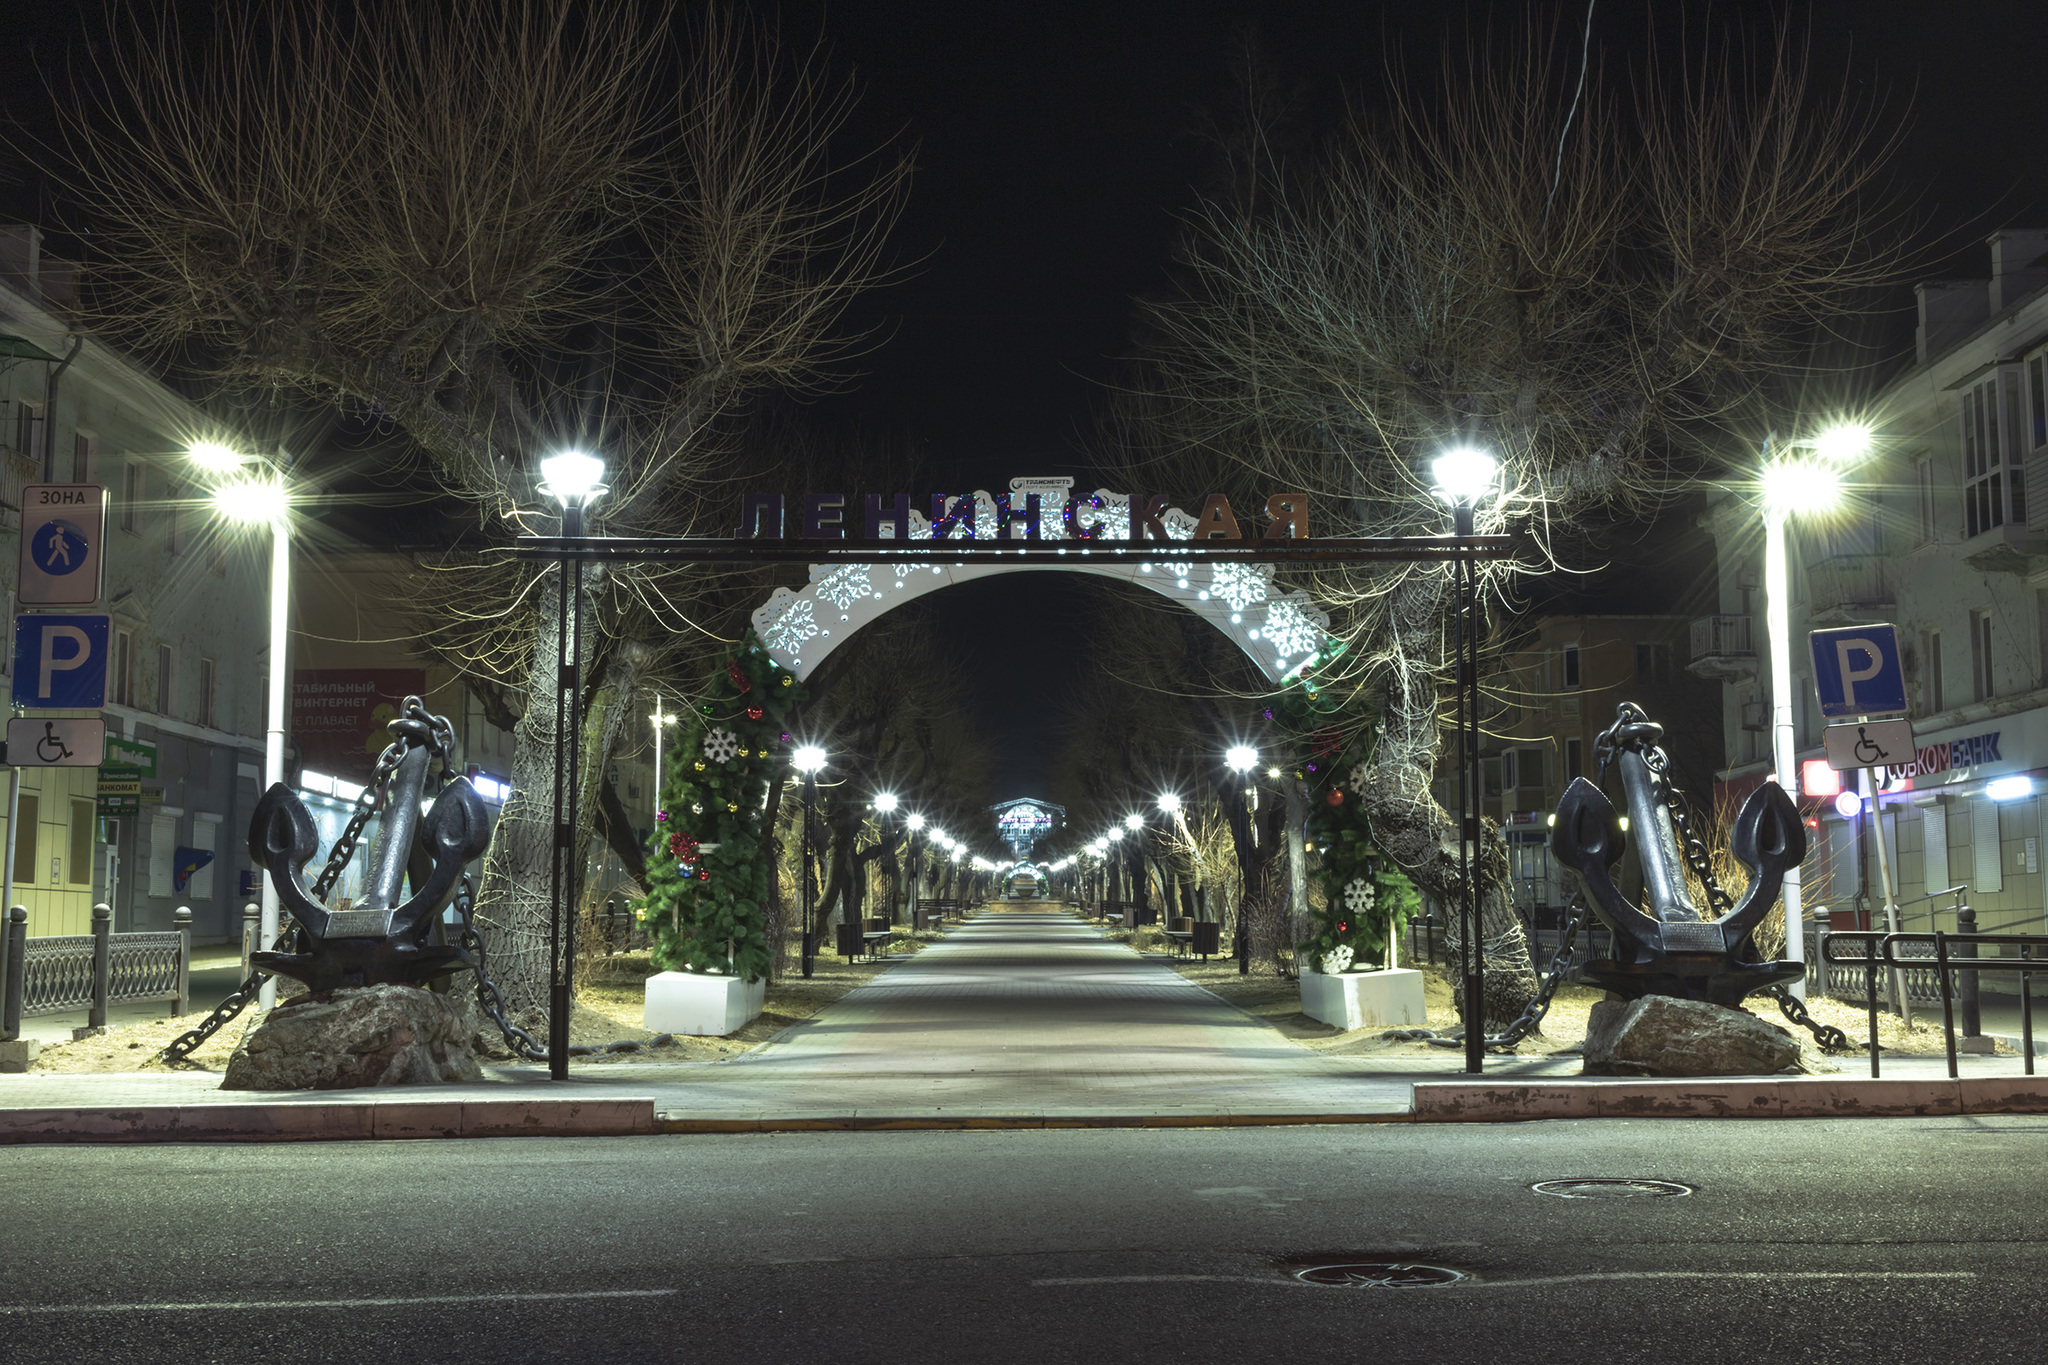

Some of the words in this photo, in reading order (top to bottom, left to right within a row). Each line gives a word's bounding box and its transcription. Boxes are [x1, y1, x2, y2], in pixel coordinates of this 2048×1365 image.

[40, 490, 86, 505] ЗОНА
[733, 492, 1309, 541] ЛЕНИНСКАЯ
[38, 625, 91, 699] P
[1836, 638, 1884, 707] P
[293, 697, 368, 708] ВИНТЕРНЕТ
[305, 715, 359, 726] ПЛАВАЕТ
